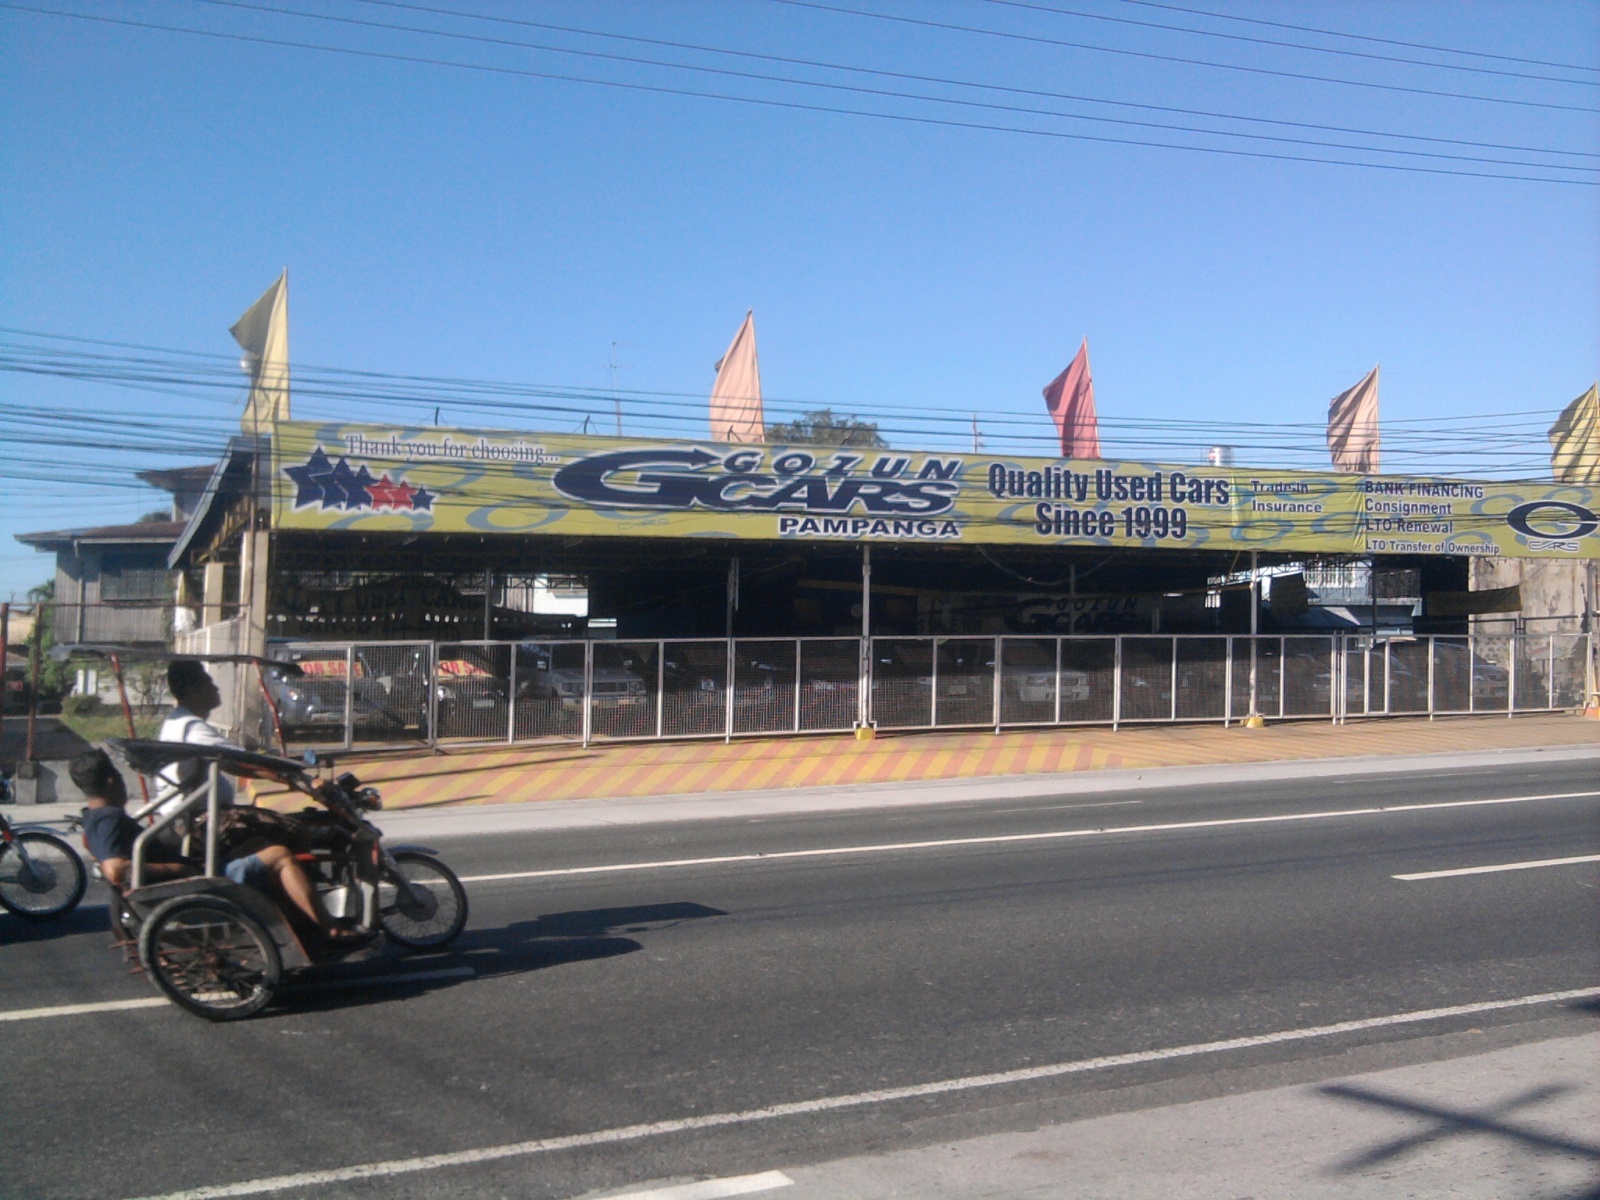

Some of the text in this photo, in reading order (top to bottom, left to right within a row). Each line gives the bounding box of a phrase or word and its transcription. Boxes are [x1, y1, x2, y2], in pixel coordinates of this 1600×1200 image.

[345, 435, 401, 456] Thank
[406, 440, 435, 462] you
[440, 438, 467, 456] for
[723, 451, 963, 479] GOZUN
[988, 463, 1231, 505] Quality Used Cars
[1364, 480, 1484, 499] BANK FINANCING
[1252, 499, 1323, 513] Insurance
[1364, 499, 1452, 516] Consignment
[779, 517, 962, 539] PAMPANGA
[1034, 502, 1188, 540] Since 1999
[1364, 518, 1454, 535] LTO Renewal
[1365, 539, 1501, 556] LTO Transfer of Ownership
